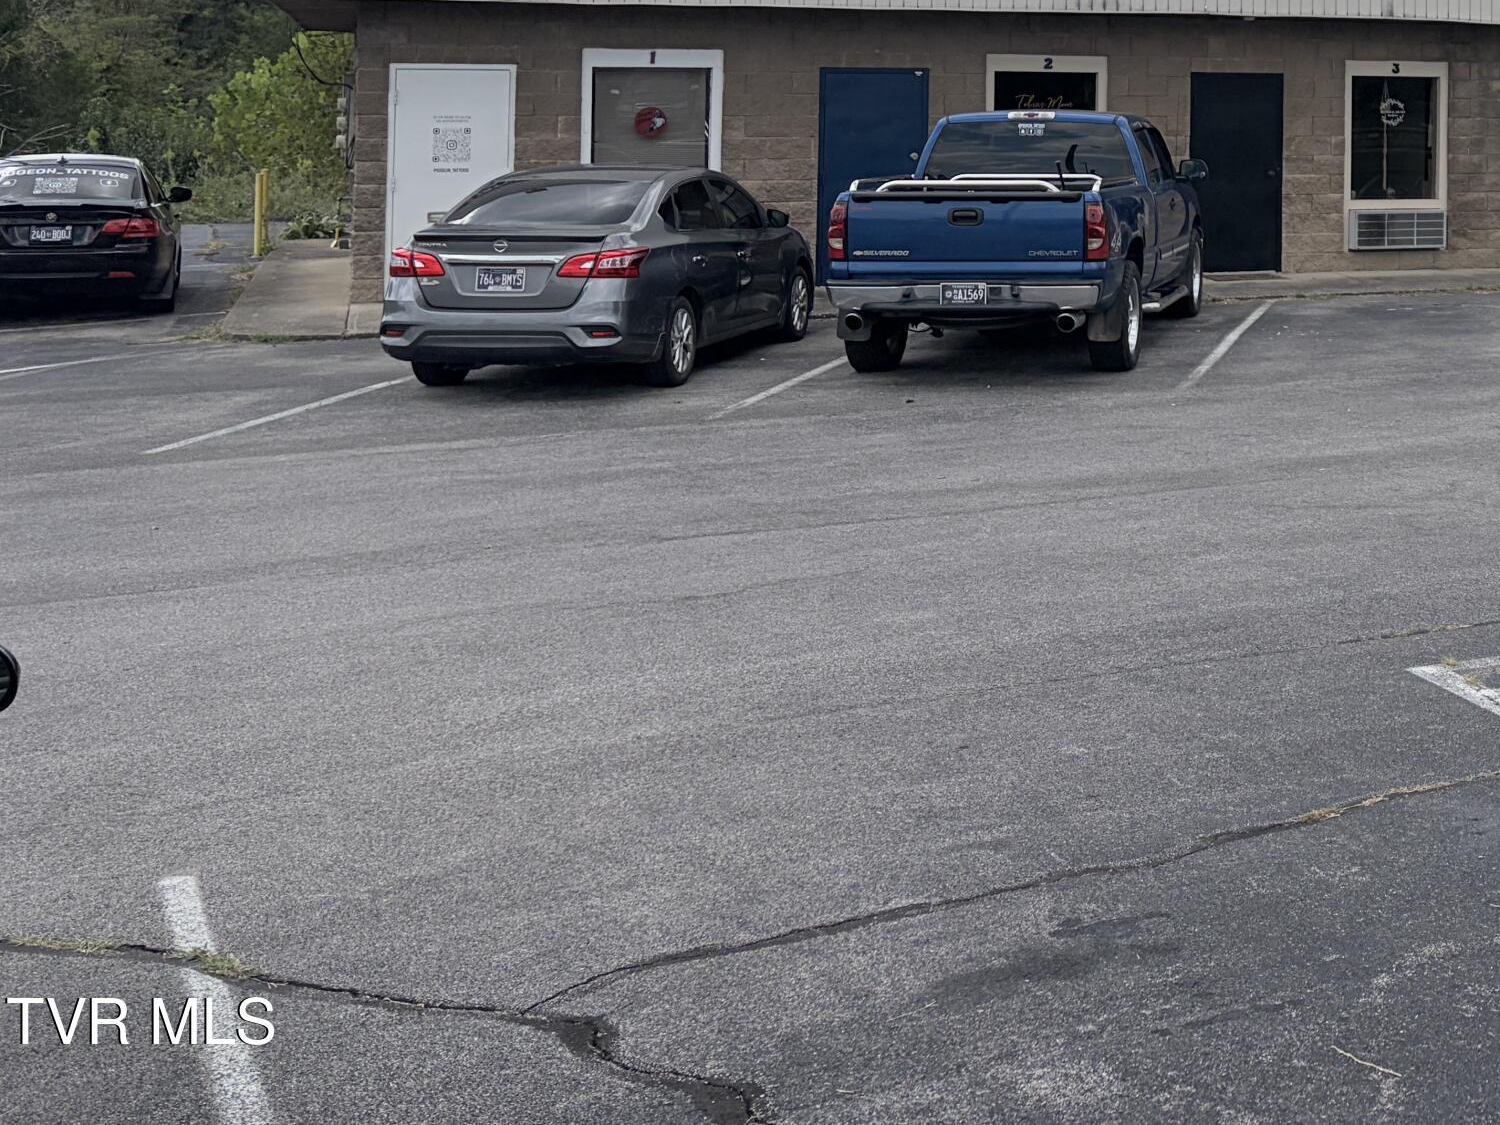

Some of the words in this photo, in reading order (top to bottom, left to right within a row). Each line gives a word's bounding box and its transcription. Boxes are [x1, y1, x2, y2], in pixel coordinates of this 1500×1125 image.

[1043, 58, 1053, 70] 2
[1392, 63, 1400, 74] 3
[479, 274, 494, 285] 764
[501, 274, 523, 285] BMYS
[957, 289, 984, 301] A1569
